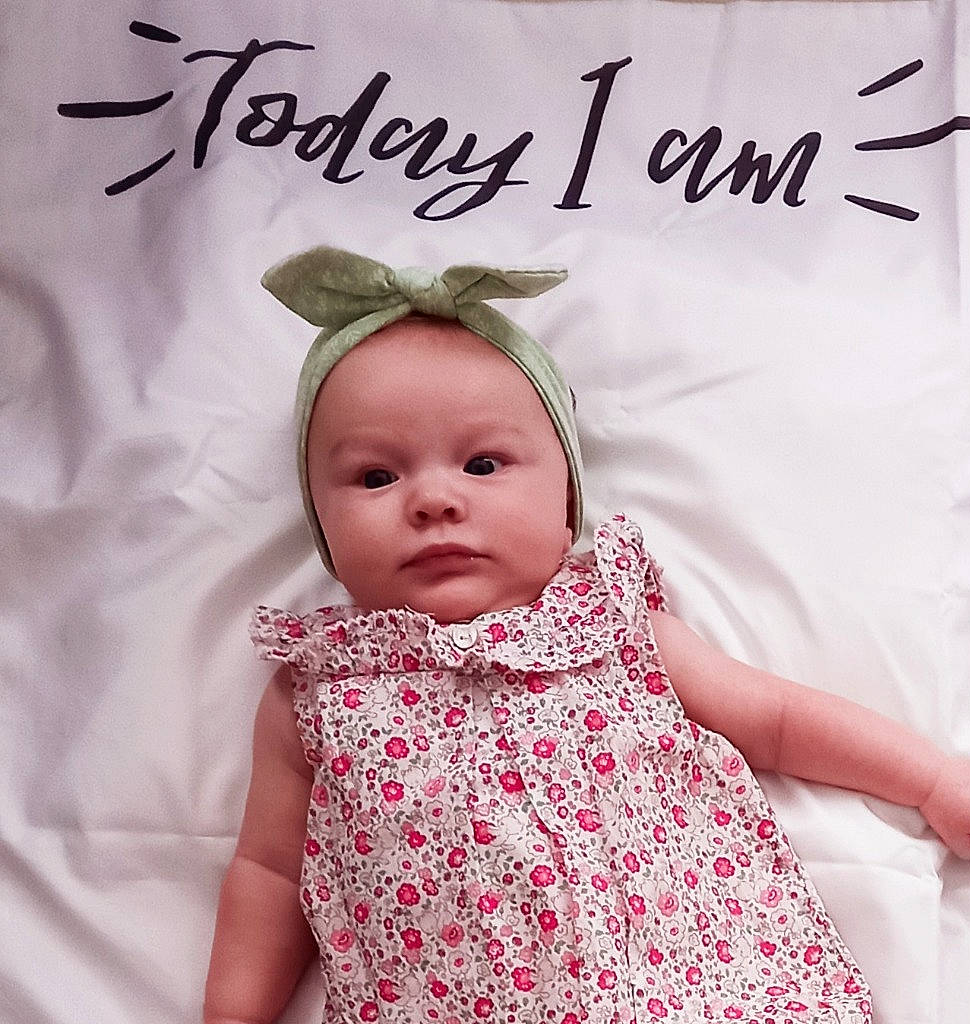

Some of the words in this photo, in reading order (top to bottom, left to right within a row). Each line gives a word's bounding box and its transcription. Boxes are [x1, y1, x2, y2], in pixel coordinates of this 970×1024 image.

[183, 39, 534, 222] Today
[553, 57, 633, 210] I
[648, 126, 822, 208] am
